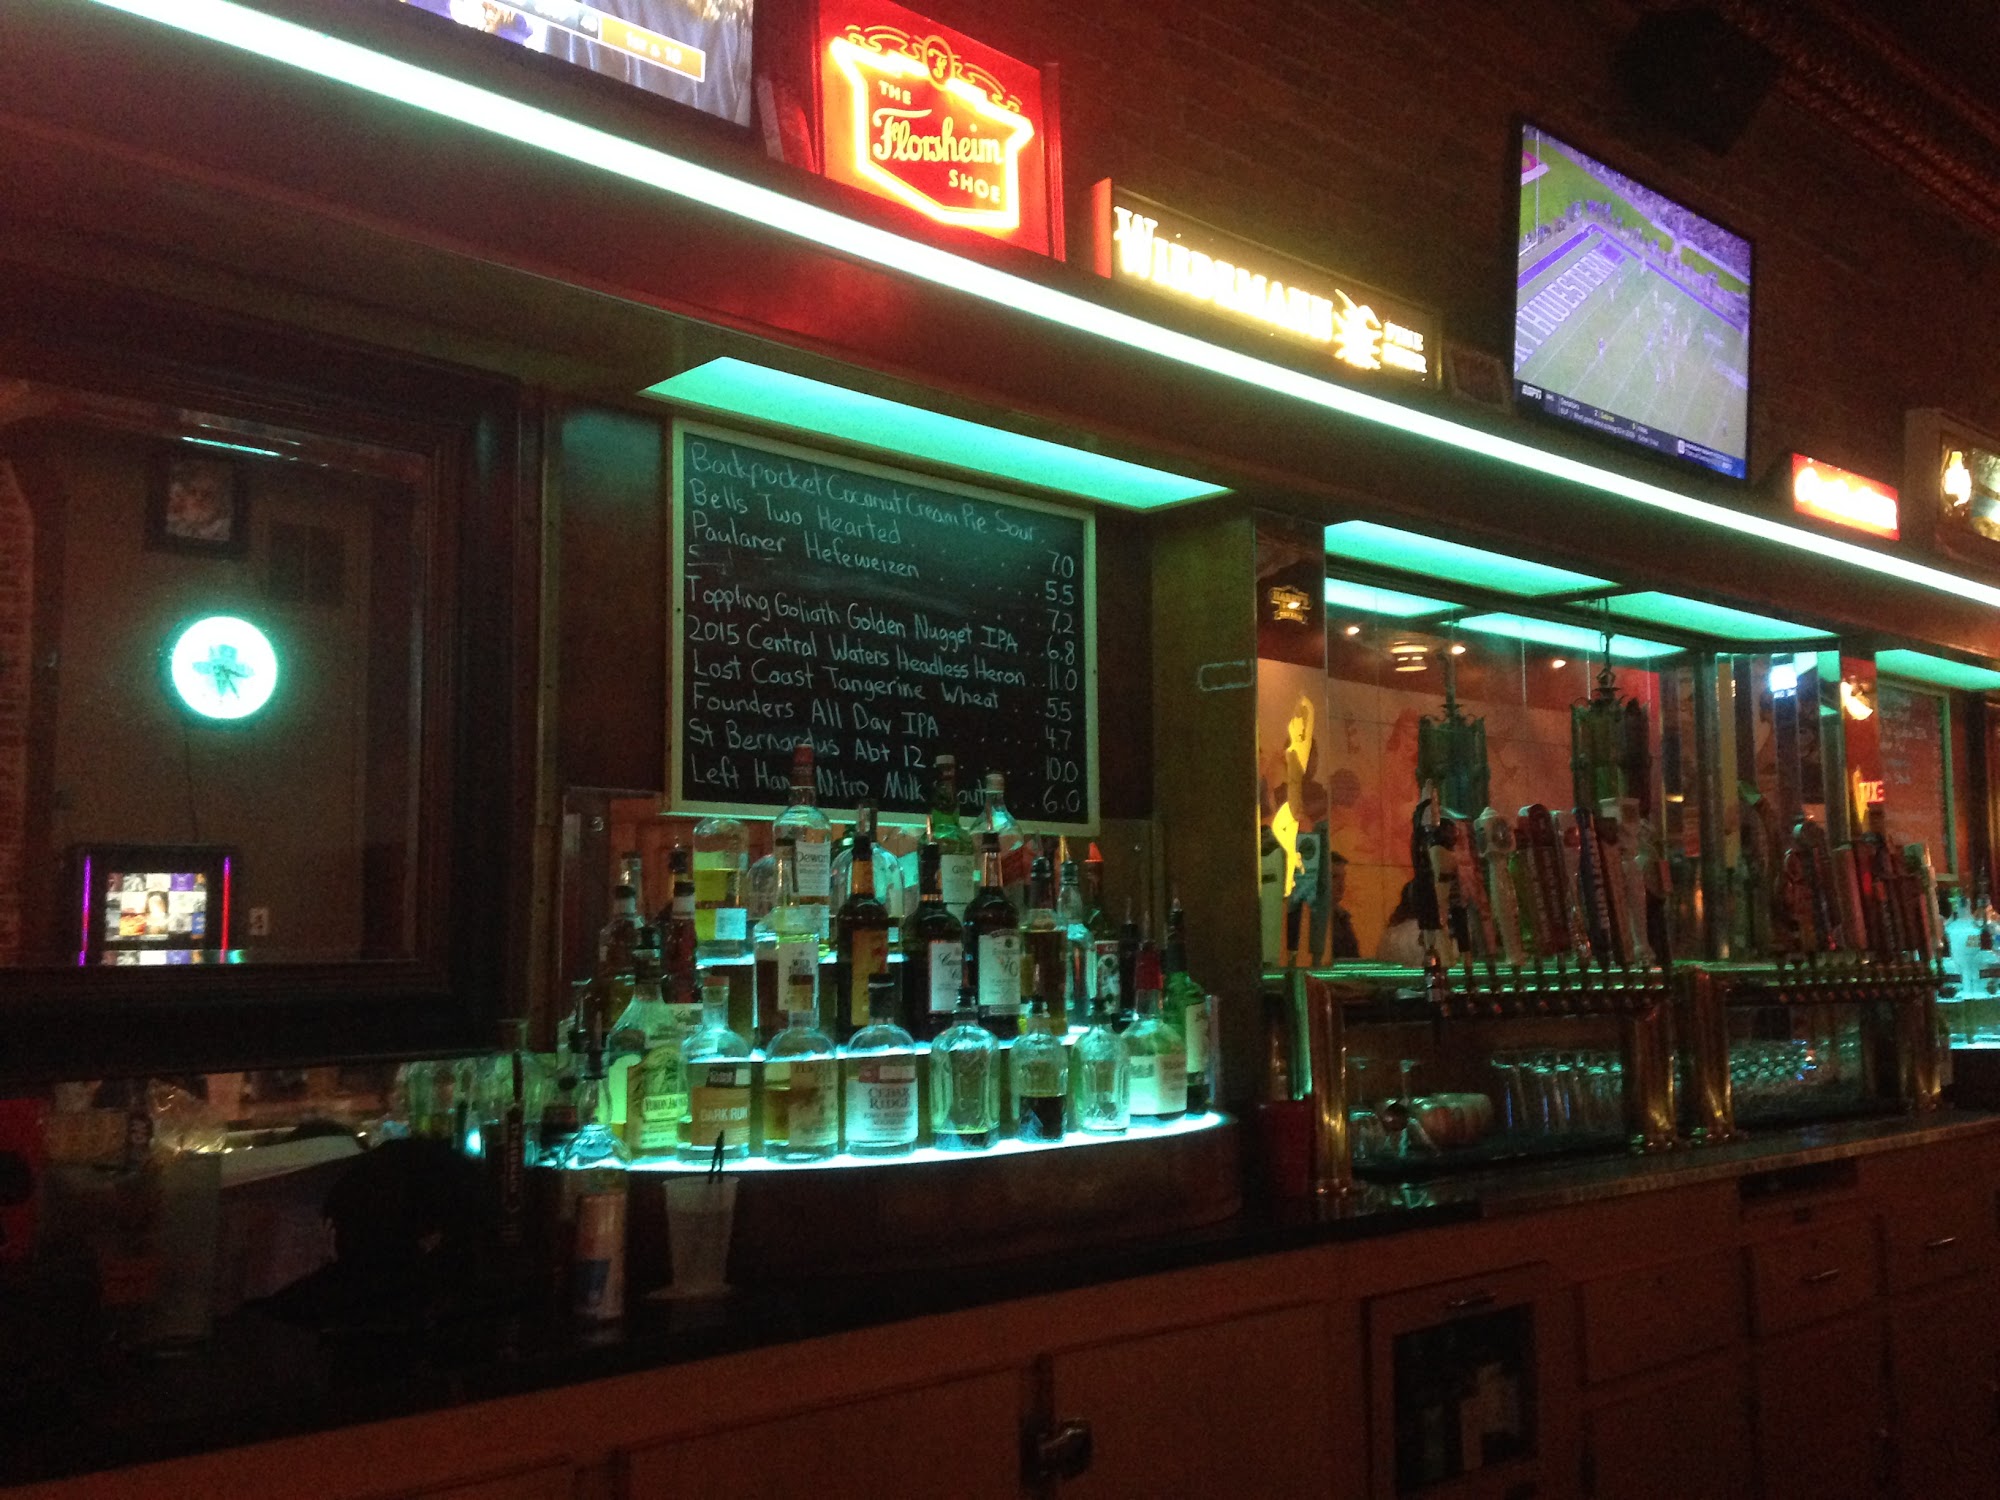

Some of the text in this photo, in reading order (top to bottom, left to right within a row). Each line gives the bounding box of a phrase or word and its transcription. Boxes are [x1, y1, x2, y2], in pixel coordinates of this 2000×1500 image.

[879, 80, 911, 105] THE
[872, 108, 1003, 164] Florsheim
[949, 169, 1000, 203] SHOE
[689, 478, 748, 514] Bells
[757, 493, 803, 525] Two
[817, 504, 900, 544] Hearted
[691, 442, 822, 496] Backpocket
[905, 492, 959, 526] Cream
[961, 503, 988, 534] Pie
[994, 509, 1033, 541] Sour
[692, 510, 1075, 606] Paulaner Hefeweizen 5.5
[685, 575, 1075, 666] Toppling Goliath Golden Nugget IPA 6.8
[688, 614, 740, 646] 2015
[747, 623, 817, 657] Central
[828, 633, 890, 667] Waters
[896, 644, 969, 679] Headless
[974, 654, 1026, 686] Heron
[1047, 608, 1075, 635] 7.2
[694, 648, 741, 680] Lost
[751, 658, 814, 689] Coast
[822, 666, 926, 701] Tangerine
[941, 682, 999, 709] Wheat
[689, 718, 714, 747] St
[855, 738, 890, 763] Abt
[904, 745, 926, 769] 12
[693, 682, 794, 719] Founders
[812, 699, 842, 729] All
[901, 711, 939, 738] IPA
[1045, 725, 1072, 751] 4.7
[691, 753, 739, 789] Left
[754, 758, 791, 790] Han
[816, 765, 869, 797] Nitro
[883, 771, 925, 801] Milk
[1043, 785, 1080, 813] 6.0
